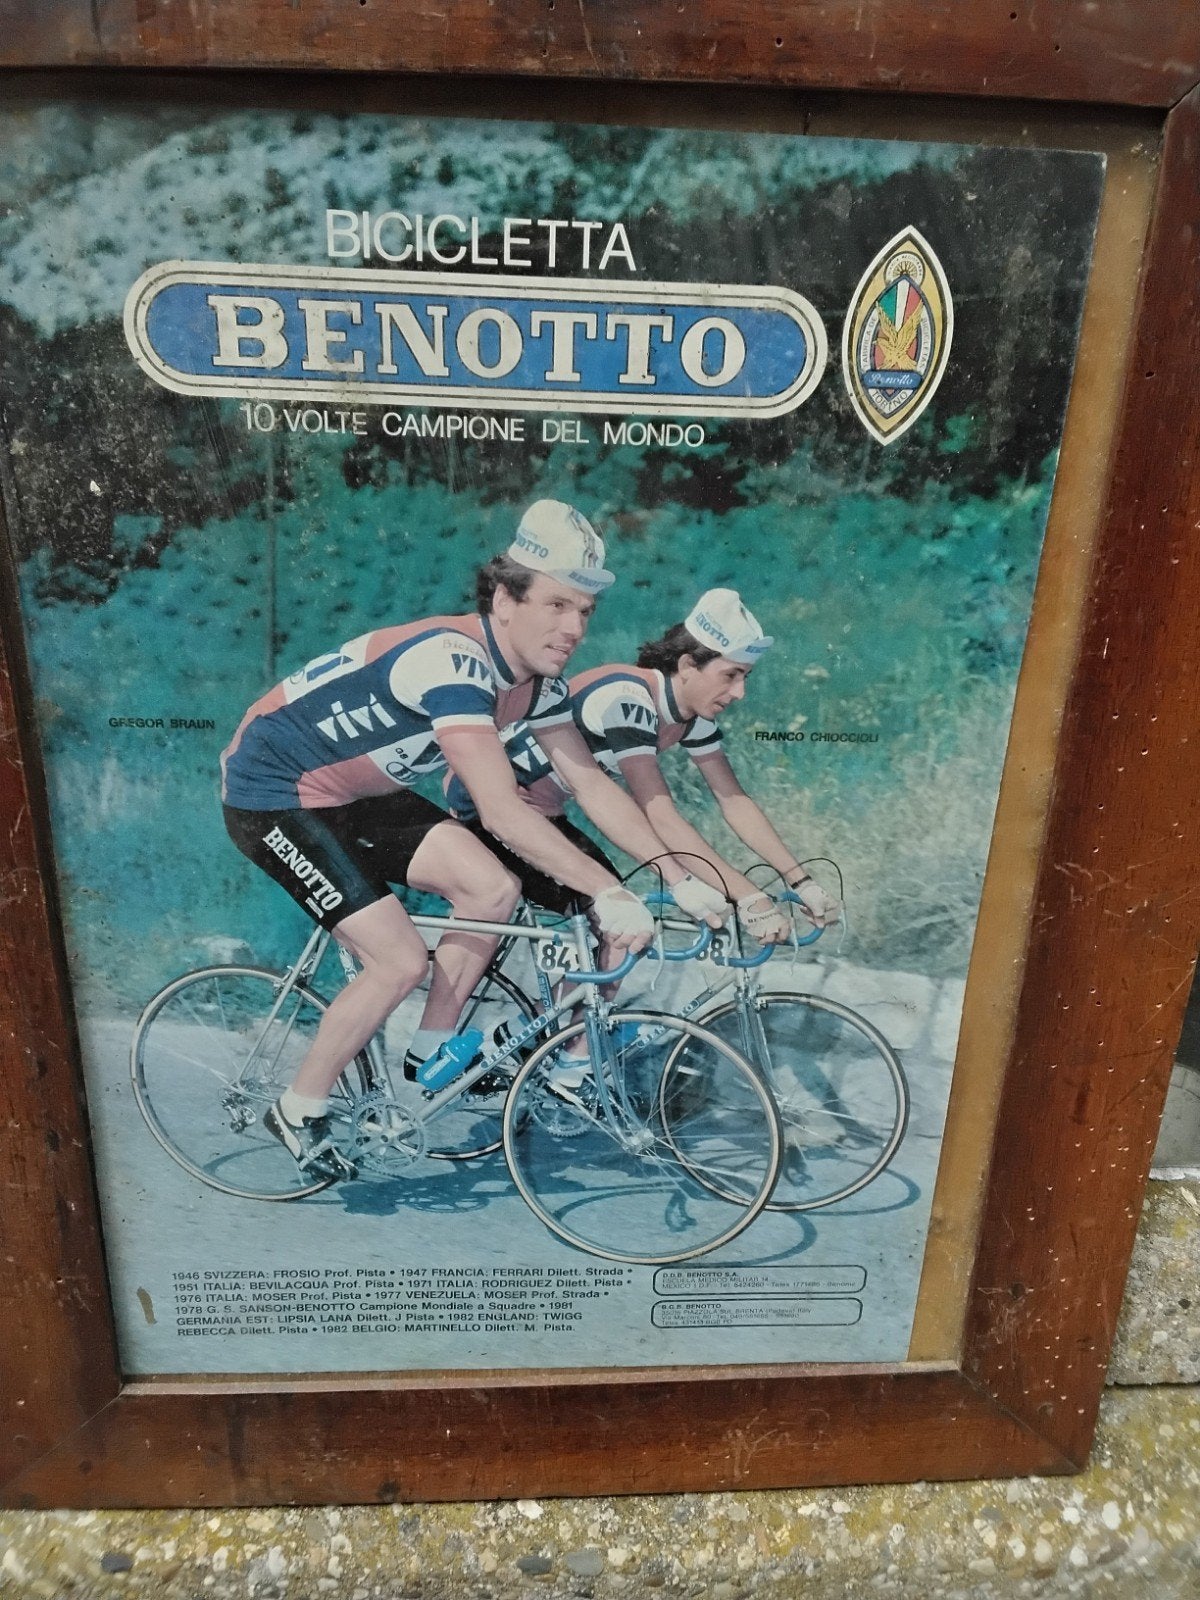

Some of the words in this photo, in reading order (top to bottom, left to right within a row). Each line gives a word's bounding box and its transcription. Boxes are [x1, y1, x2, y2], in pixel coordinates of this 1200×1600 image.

[326, 208, 638, 272] BICICLETTA
[207, 294, 746, 388] BENOTTO
[872, 390, 908, 411] TORINO
[240, 402, 275, 432] 10
[283, 408, 368, 436] VOLTE
[382, 412, 525, 441] CAMPIONE
[542, 419, 589, 444] DEL
[603, 421, 704, 448] MONDO
[108, 717, 164, 728] GREGOR
[170, 718, 215, 729] BRAUN
[754, 731, 805, 741] FRANCO
[810, 732, 879, 743] CHIOCCIOLI
[262, 826, 343, 911] BENOTTO
[172, 1272, 199, 1280] 1946
[203, 1271, 270, 1279] SVIZZERA:
[273, 1270, 321, 1278] FROSIO
[324, 1269, 351, 1278] Prof.
[356, 1269, 386, 1277] Pista
[400, 1268, 427, 1277] 1947
[431, 1268, 488, 1277] FRANCIA:
[492, 1268, 543, 1277] FERRARI
[547, 1268, 581, 1276] Dilett.
[585, 1267, 624, 1276] Strada
[173, 1283, 198, 1291] 1951
[203, 1282, 245, 1291] ITALIA:
[249, 1281, 329, 1290] BEVILACQUA
[333, 1281, 361, 1289] Prof.
[365, 1280, 394, 1288] Pista
[408, 1280, 432, 1288] 1971
[437, 1280, 478, 1288] ITALIA:
[481, 1280, 552, 1288] RODRIGUEZ
[556, 1279, 590, 1288] Dilett.
[594, 1279, 623, 1287] Pista
[175, 1294, 201, 1303] 1976
[206, 1294, 247, 1302] ITALIA:
[252, 1293, 296, 1301] MOSER
[300, 1292, 328, 1300] Prof.
[332, 1292, 362, 1300] Pista
[374, 1291, 401, 1300] 1977
[406, 1291, 480, 1299] VENEZUELA:
[484, 1291, 527, 1299] MOSER
[531, 1291, 558, 1299] Prof.
[562, 1290, 600, 1298] Strada
[175, 1306, 202, 1314] 1978
[206, 1305, 220, 1314] G.
[223, 1305, 235, 1313] S.
[239, 1303, 355, 1313] SANSON-BENOTTO
[359, 1302, 418, 1312] Campione
[421, 1302, 474, 1310] Mondiale
[488, 1302, 536, 1312] Squadre
[549, 1301, 573, 1310] 1981
[176, 1317, 241, 1326] GERMANIA
[246, 1316, 273, 1324] EST:
[277, 1315, 316, 1324] LIPSIA
[320, 1314, 352, 1323] LANA
[357, 1313, 391, 1322] Dilett.
[394, 1313, 402, 1321] J
[406, 1313, 435, 1321] Pista
[448, 1313, 474, 1321] 1982
[478, 1313, 539, 1321] ENGLAND:
[542, 1312, 583, 1321] TWIGG
[177, 1327, 236, 1336] REBECCA
[240, 1326, 275, 1335] Dilett.
[278, 1325, 308, 1334] Pista
[321, 1325, 348, 1333] 1982
[352, 1324, 400, 1333] BELGIO:
[404, 1323, 481, 1332] MARTINELLO
[485, 1323, 519, 1332] Dilett.
[524, 1323, 538, 1332] M.
[543, 1323, 576, 1332] Pista.
